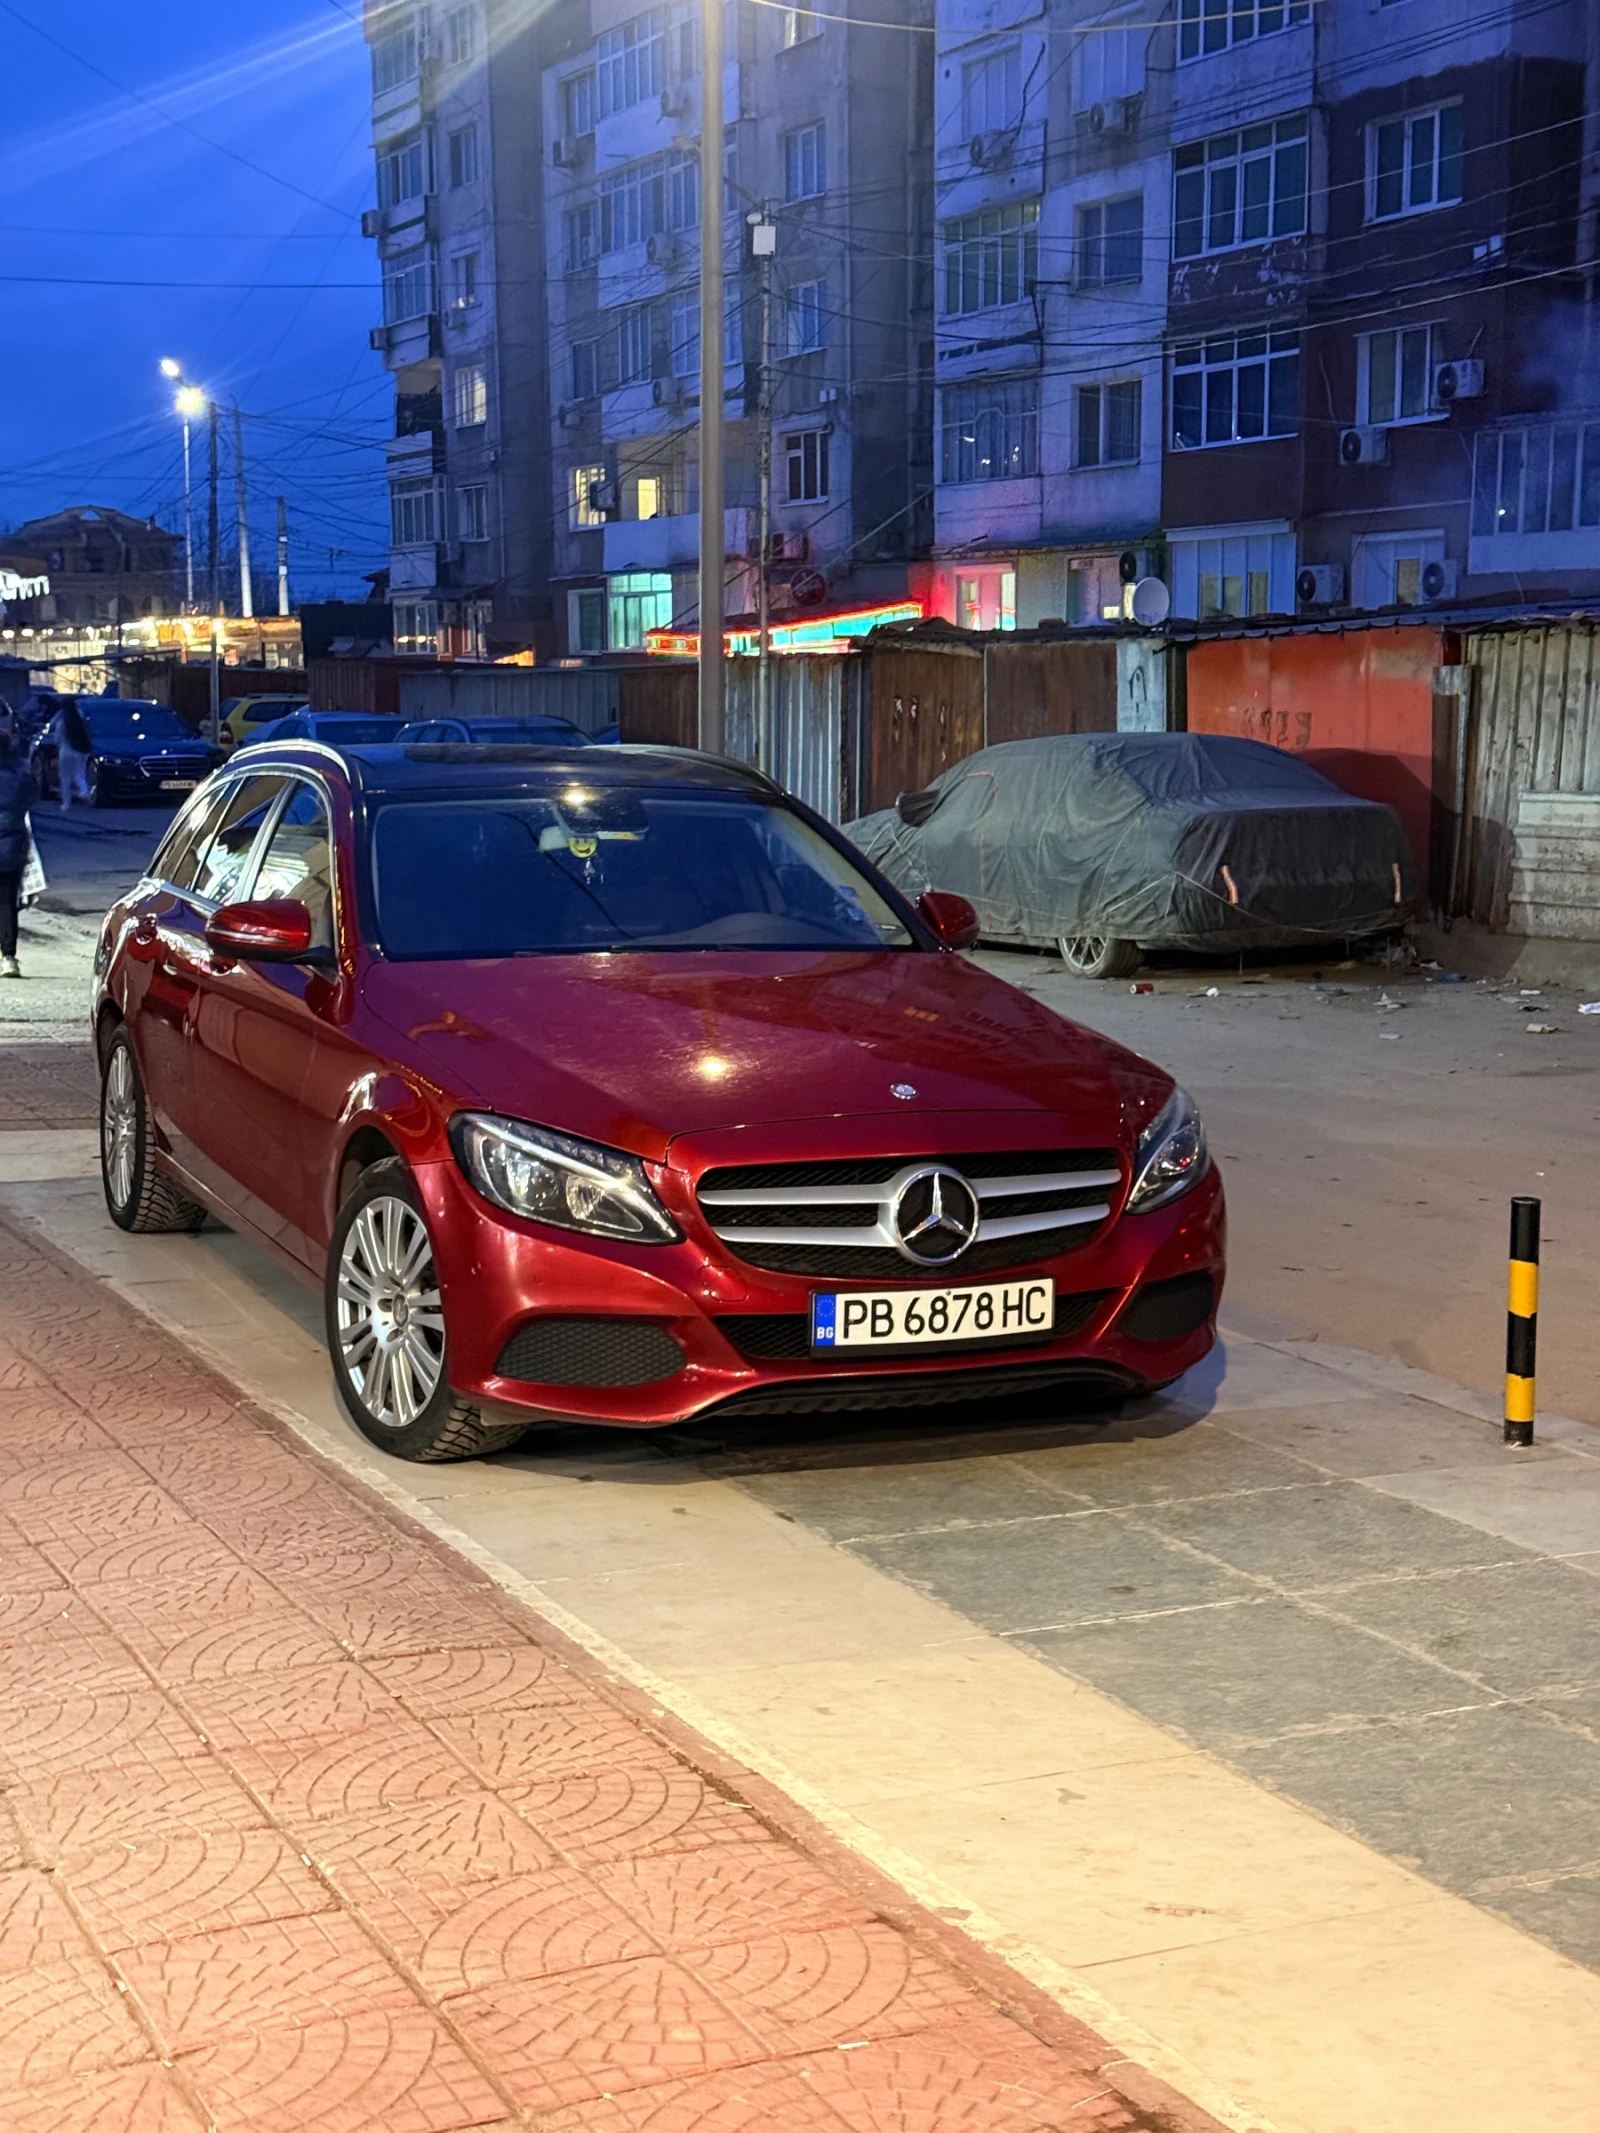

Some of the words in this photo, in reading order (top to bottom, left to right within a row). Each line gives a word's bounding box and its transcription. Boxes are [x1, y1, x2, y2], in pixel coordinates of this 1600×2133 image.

[843, 1299, 894, 1339] PB
[904, 1292, 994, 1335] 6878
[1002, 1286, 1046, 1328] HC
[817, 1326, 834, 1339] BG
